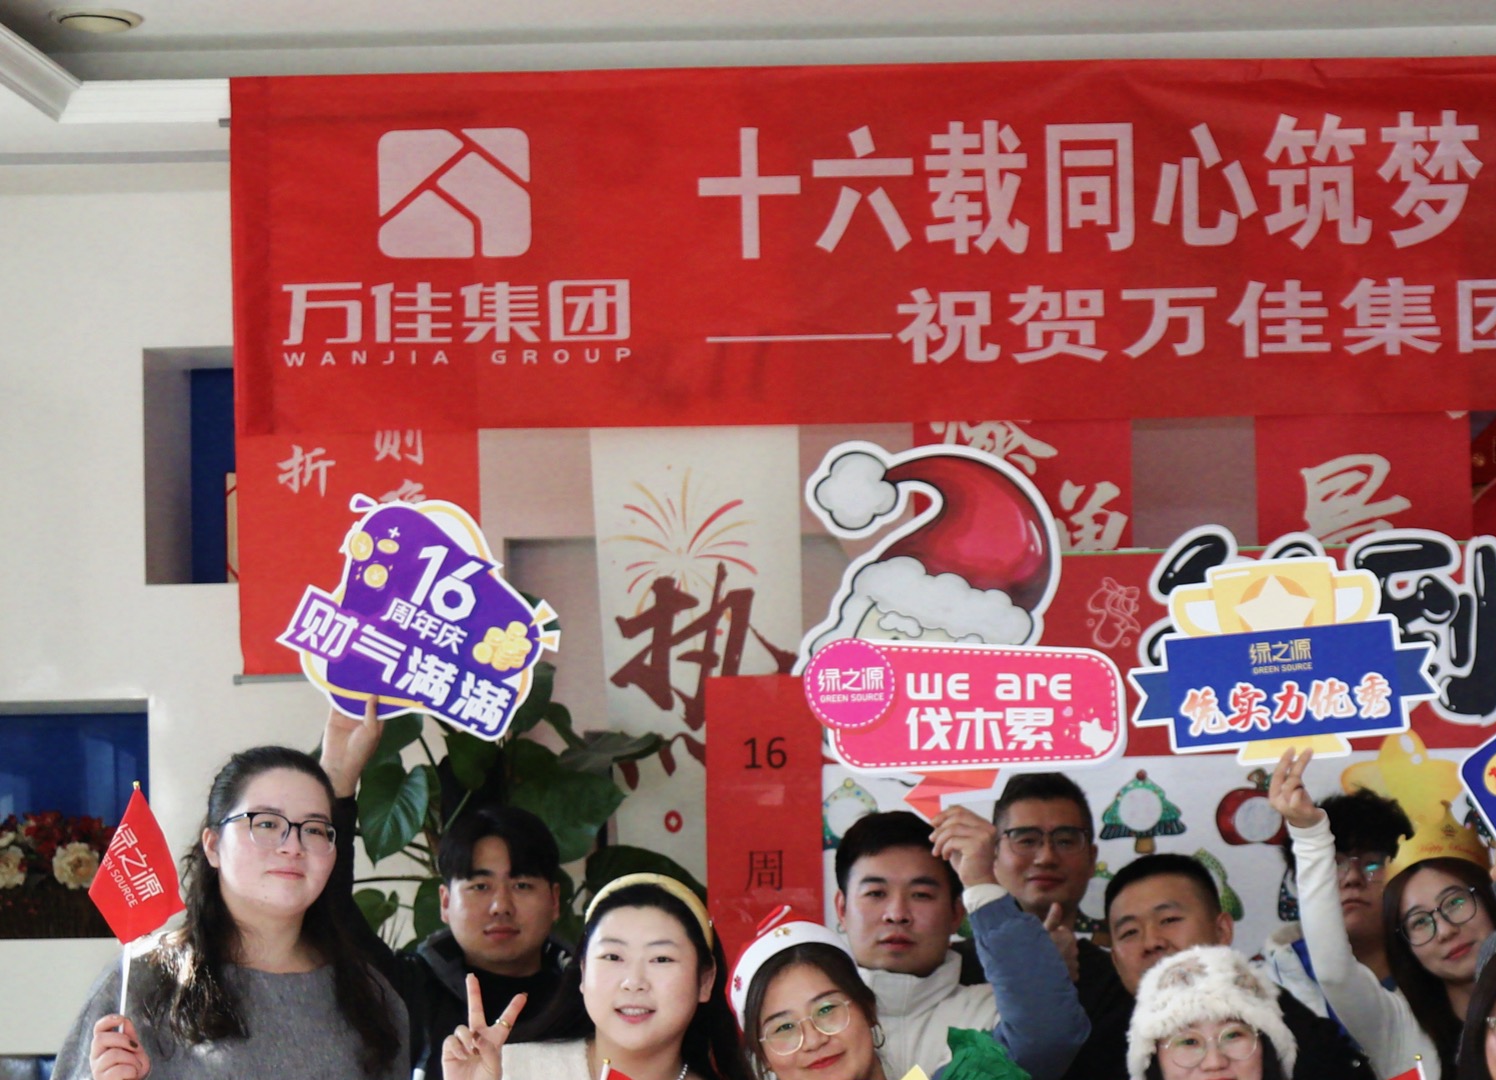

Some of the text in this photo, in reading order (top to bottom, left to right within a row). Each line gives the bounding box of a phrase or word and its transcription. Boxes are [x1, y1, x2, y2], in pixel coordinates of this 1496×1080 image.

[698, 109, 1483, 259] 十六载同心筑梦
[282, 279, 631, 346] 万佳集团
[283, 346, 632, 368] WANJIA GROUP
[409, 545, 484, 622] 16
[381, 597, 468, 655] 周年庆
[295, 599, 512, 732] 财气满满
[1249, 638, 1312, 665] 绿之源
[1252, 661, 1313, 675] GREEN SOURCE
[817, 666, 885, 693] 绿之源
[819, 692, 885, 703] GREEN SOURCE
[1182, 673, 1392, 735] 凭实力优秀
[905, 706, 1054, 751] 伐木累
[110, 868, 139, 908] SOURCE
